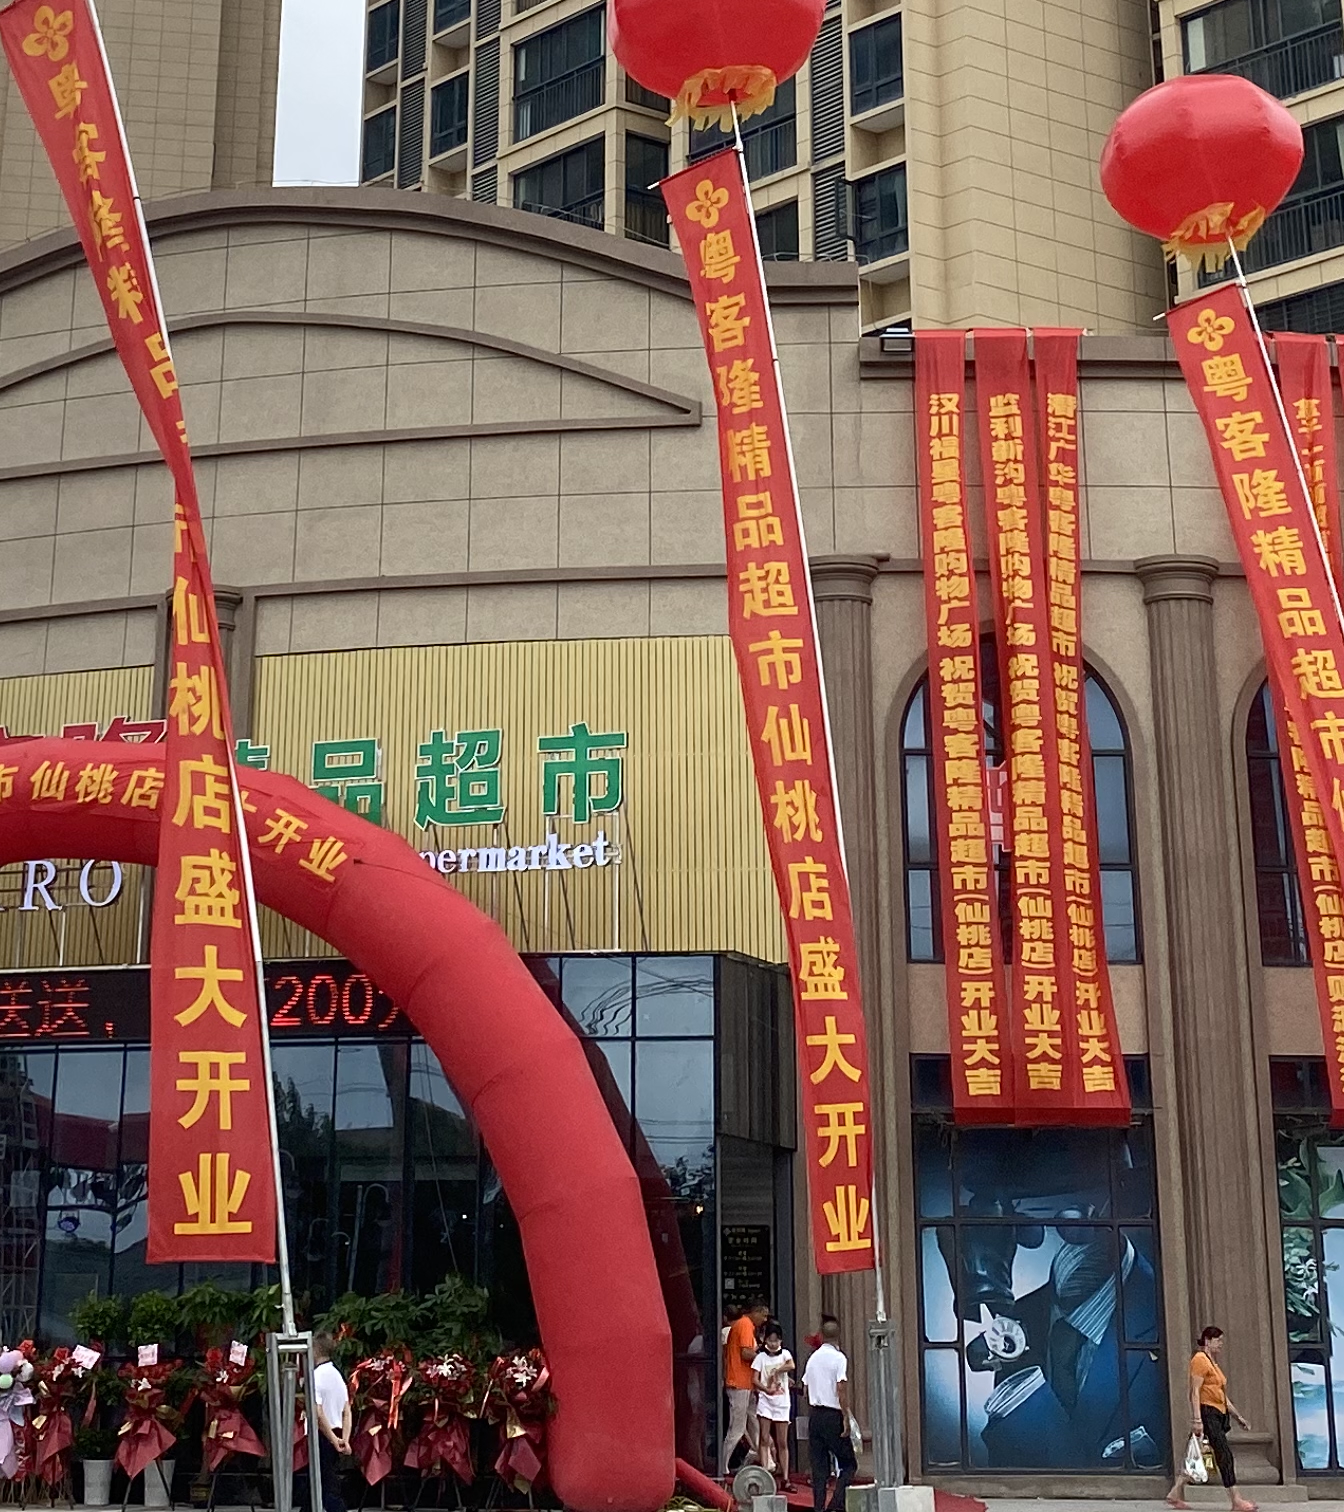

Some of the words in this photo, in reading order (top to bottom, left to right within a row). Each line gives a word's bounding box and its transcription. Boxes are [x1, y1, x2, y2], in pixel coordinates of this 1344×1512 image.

[698, 231, 872, 1253] 粤客隆精品超市仙桃店盛大开业
